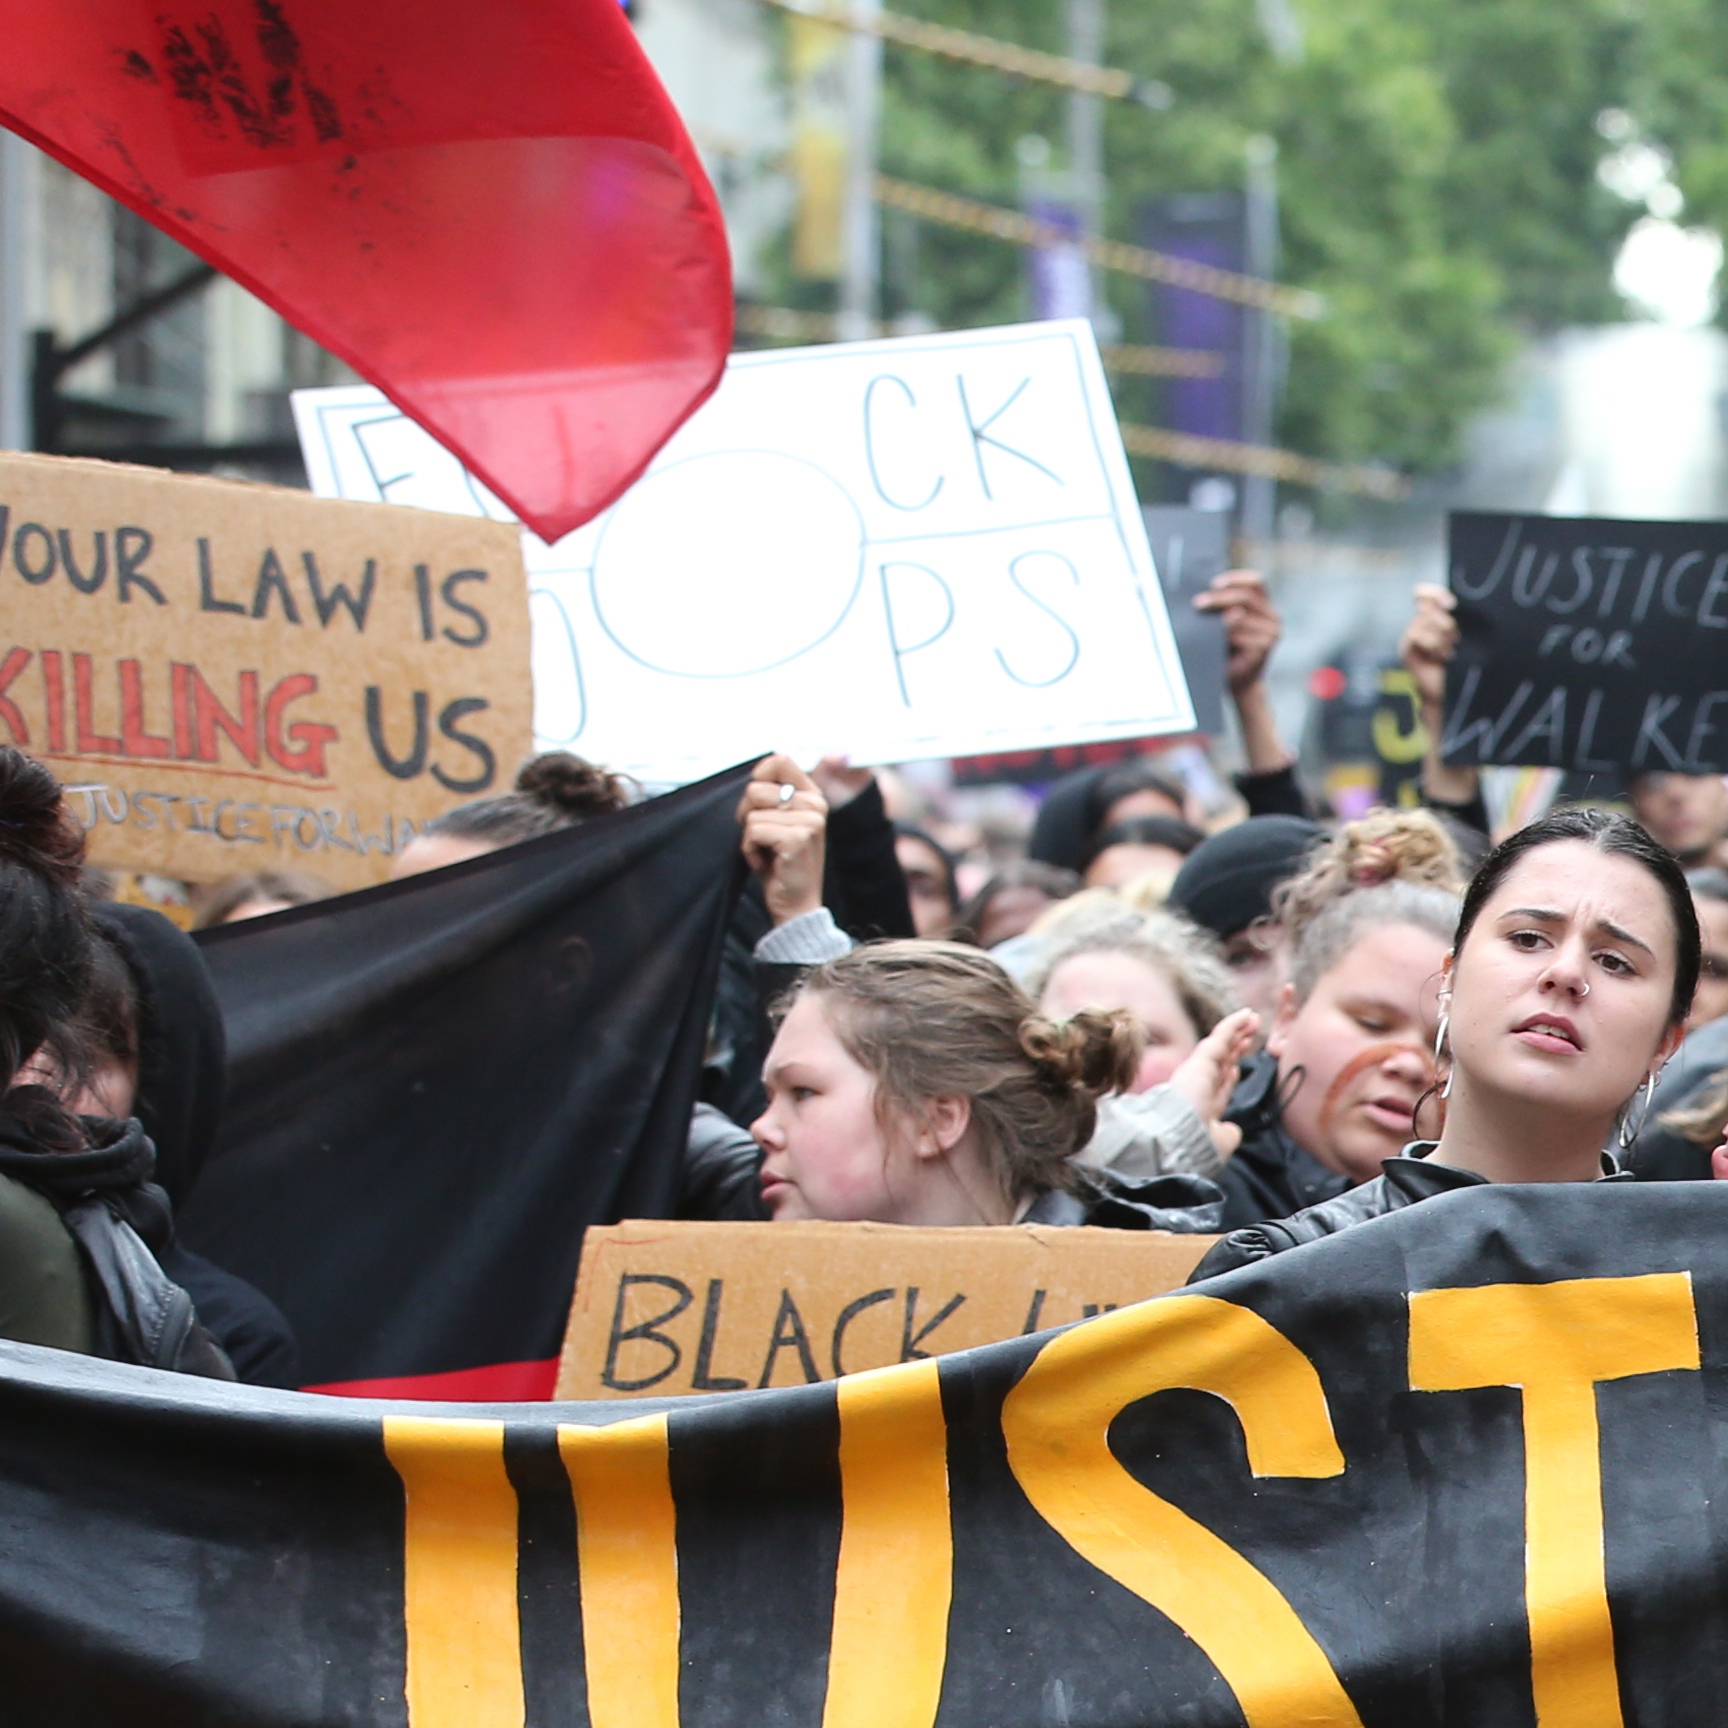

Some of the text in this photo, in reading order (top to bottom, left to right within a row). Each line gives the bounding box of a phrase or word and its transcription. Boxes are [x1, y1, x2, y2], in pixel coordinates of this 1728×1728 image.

[196, 535, 377, 634] LAW
[414, 562, 490, 648] IS
[1538, 624, 1638, 668] FOR
[0, 644, 496, 794] KILLING US
[600, 1271, 968, 1391] BLACK
